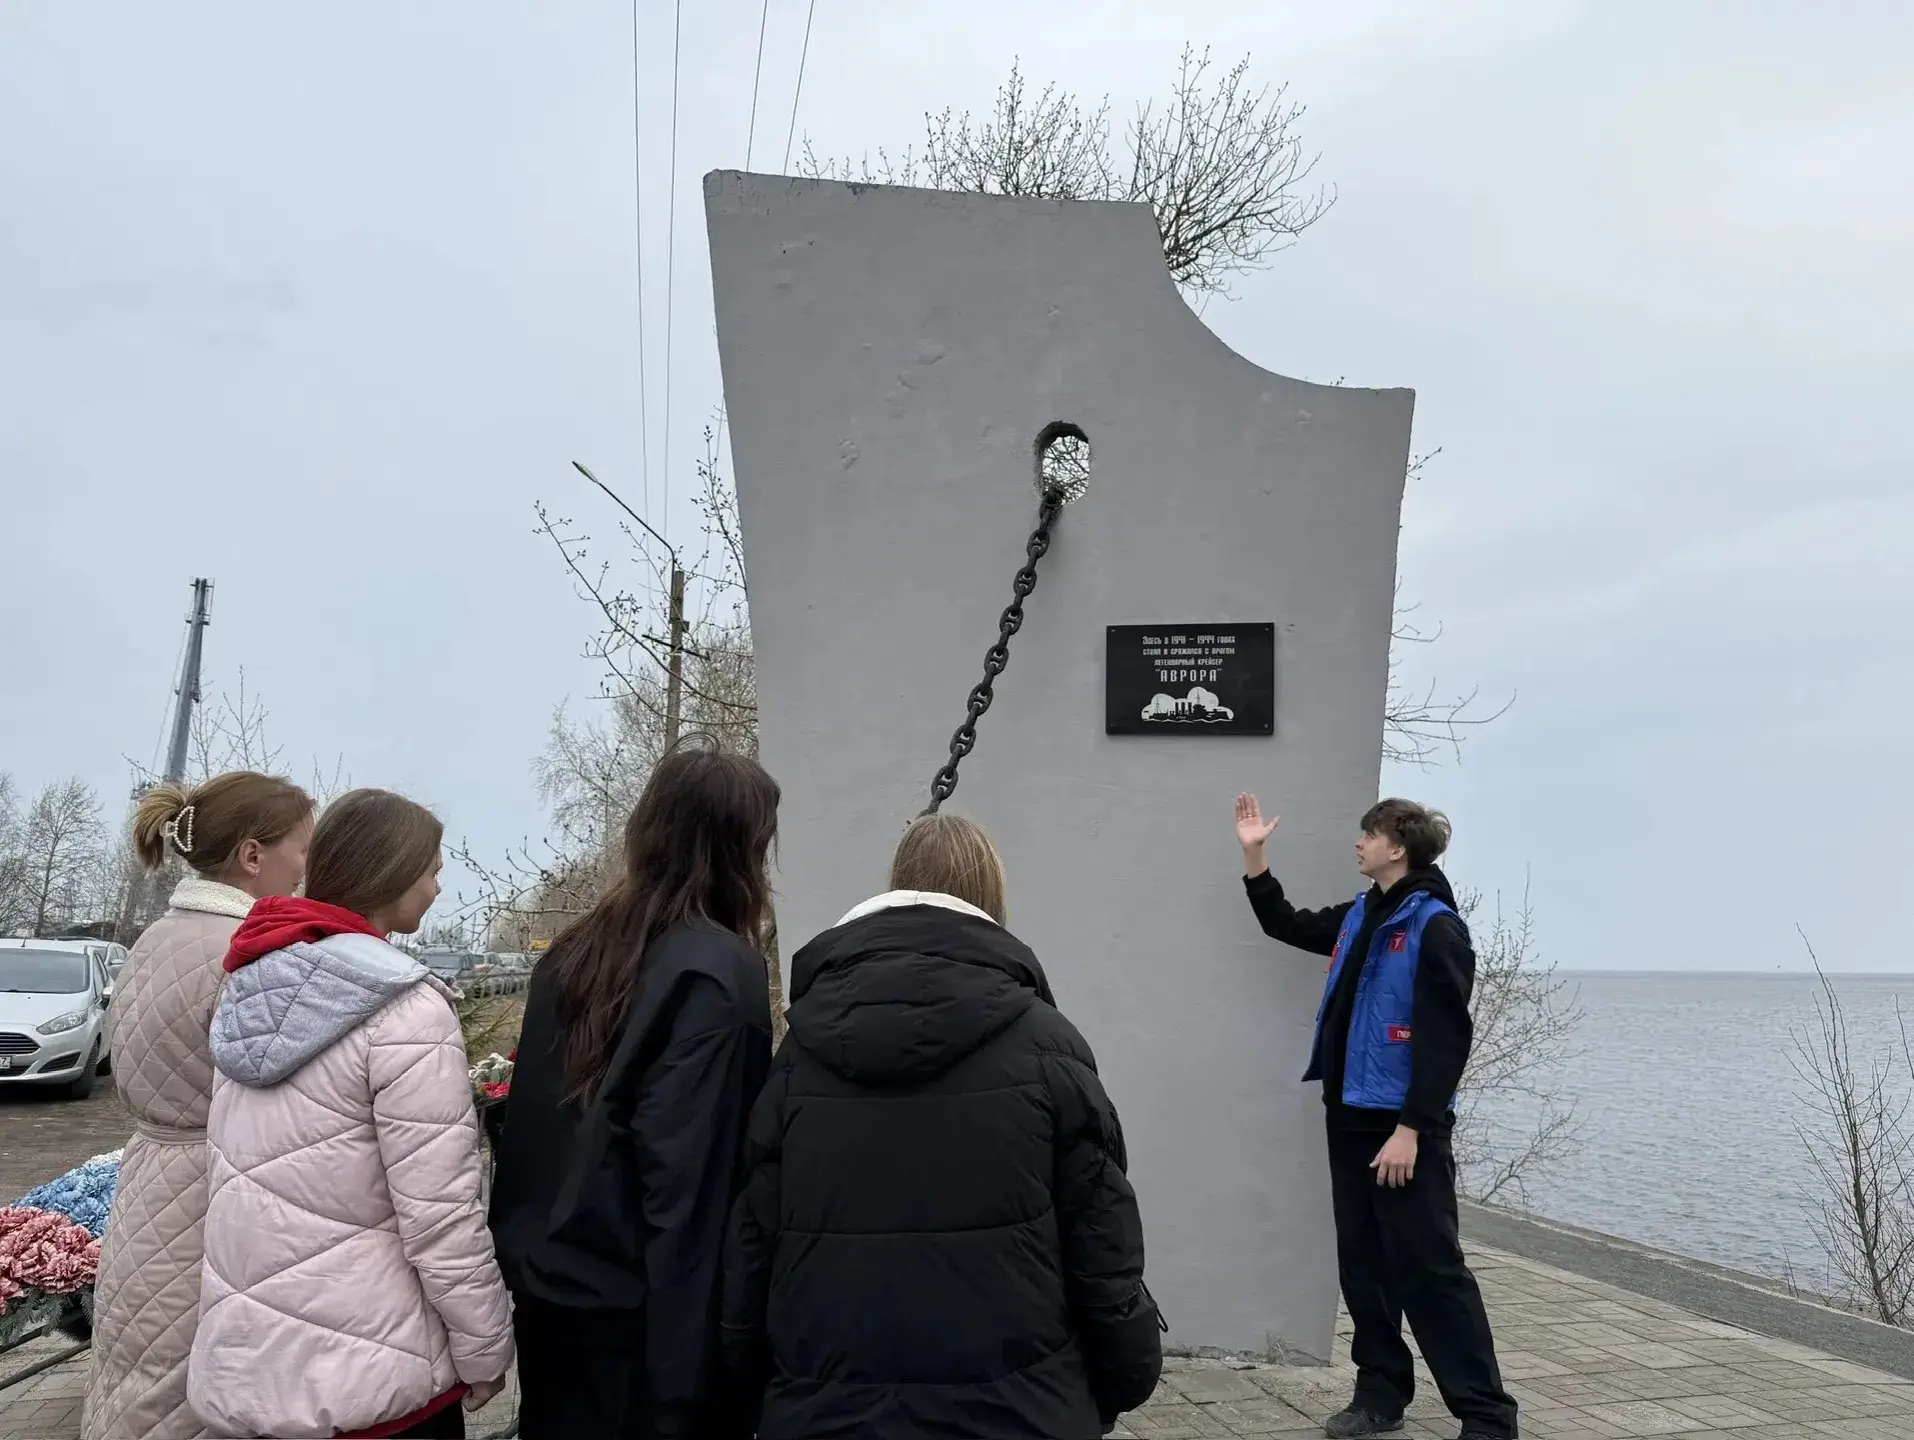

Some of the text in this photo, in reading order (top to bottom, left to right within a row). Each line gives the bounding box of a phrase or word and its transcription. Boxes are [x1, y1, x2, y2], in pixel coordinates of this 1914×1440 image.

[1197, 634, 1215, 644] 1944
[1217, 635, 1236, 644] ГОДАХ
[1142, 648, 1161, 656] СТОЯЛ
[1170, 647, 1202, 655] СРАЖАЛСЯ
[1204, 647, 1209, 655] С
[1211, 647, 1235, 655] ВРАГОМ
[1154, 657, 1223, 666] ЛЕГЕНДАРНЫЙ КРЕЙСЕР
[1155, 668, 1222, 682] "АВРОРА"
